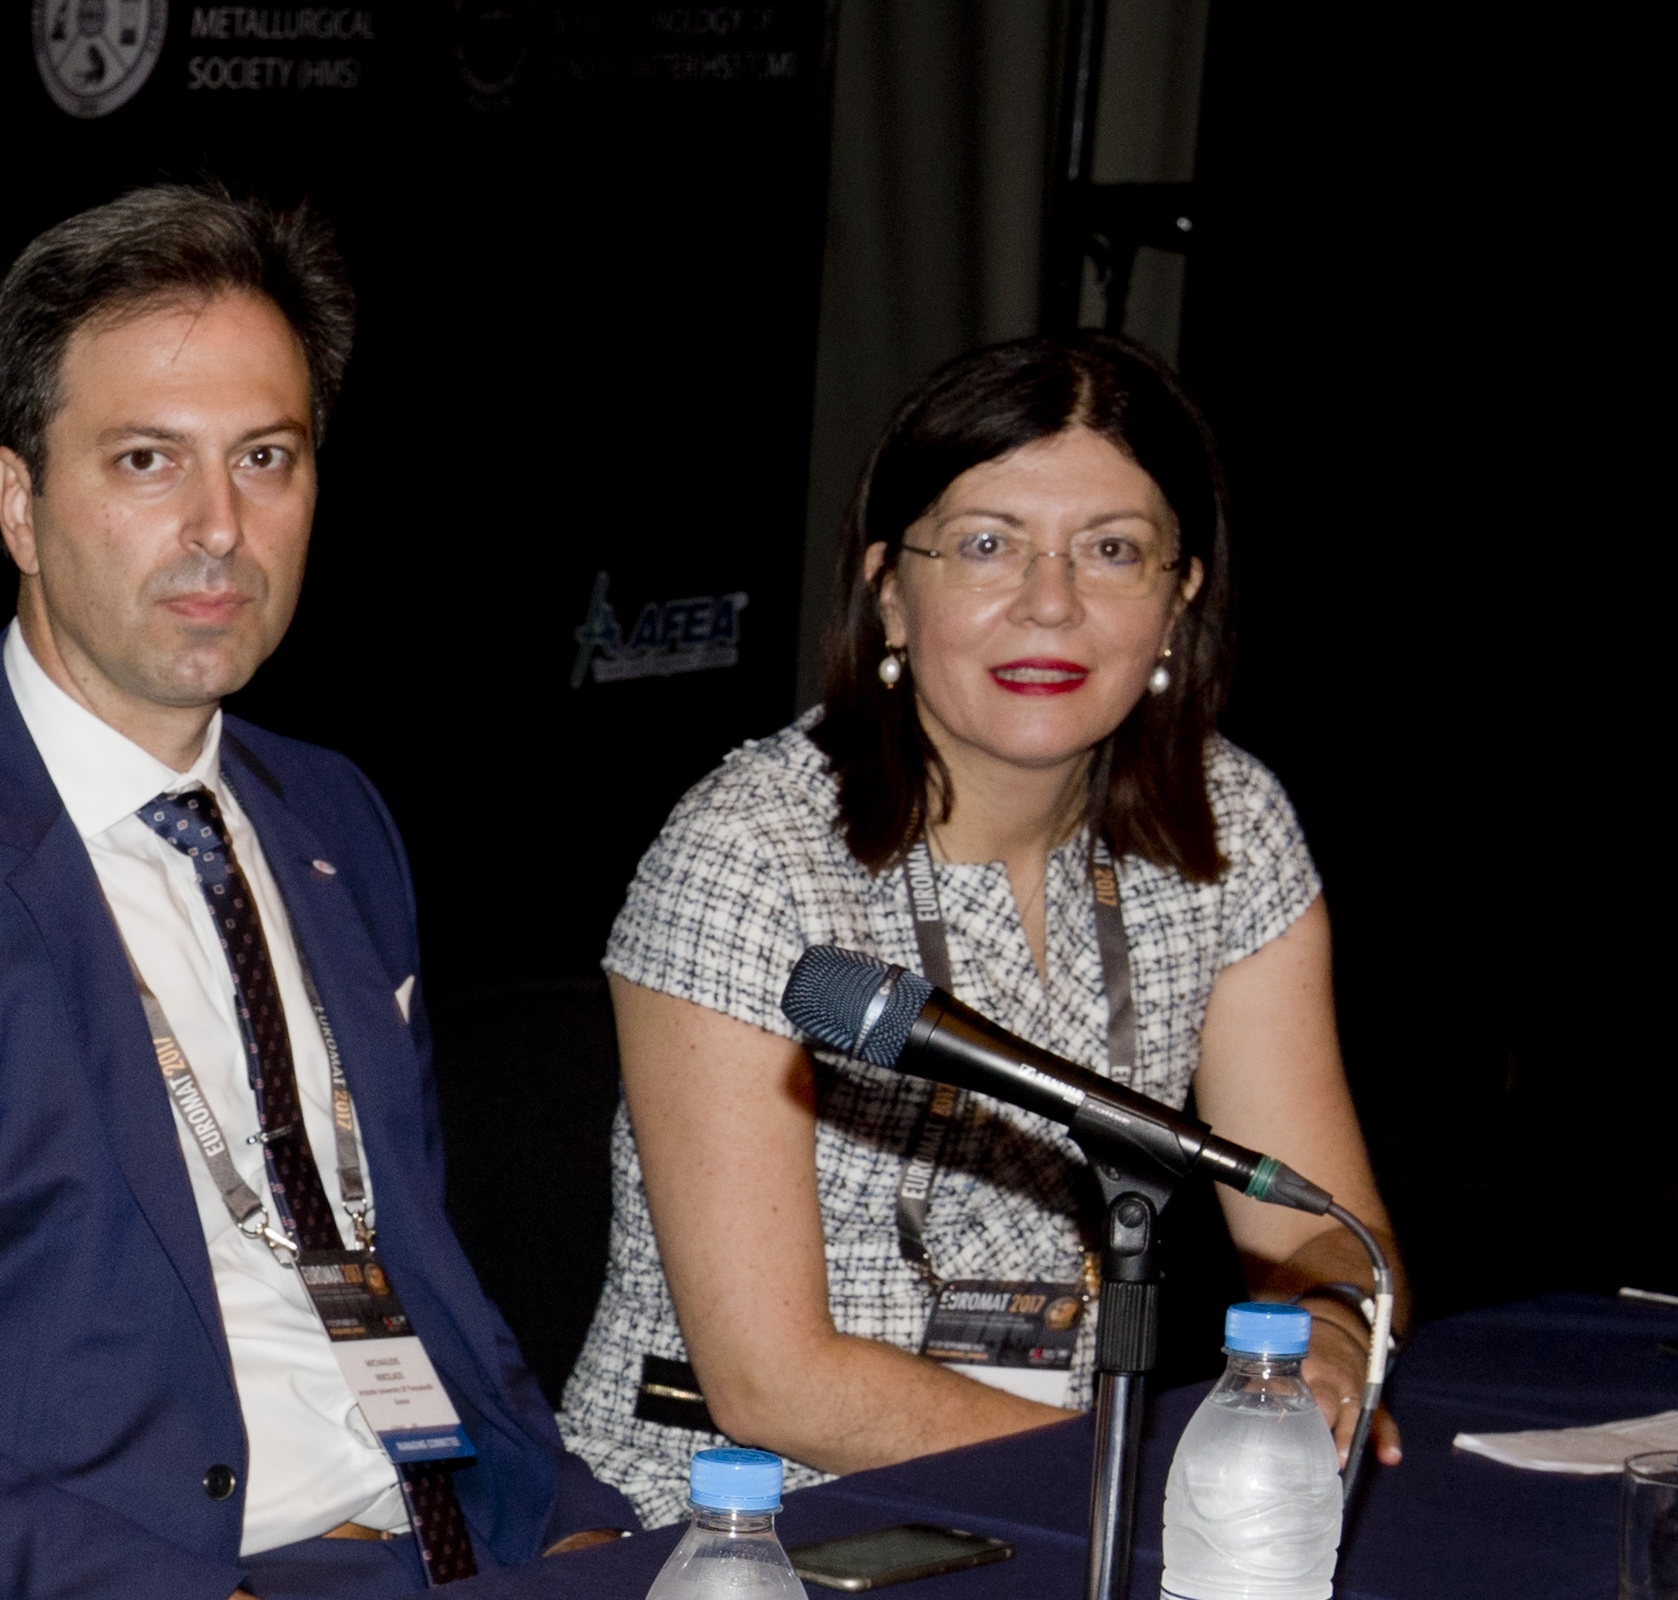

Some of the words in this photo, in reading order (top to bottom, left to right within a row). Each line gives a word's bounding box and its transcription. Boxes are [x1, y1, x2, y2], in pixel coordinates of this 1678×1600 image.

[192, 6, 375, 40] METALLURGICAL
[187, 56, 294, 90] SOCIETY
[907, 842, 941, 922] EUROMA
[1093, 867, 1119, 908] 2017
[169, 1074, 225, 1157] EUROMAT
[334, 1089, 353, 1131] 2017
[1009, 1293, 1047, 1314] 2017
